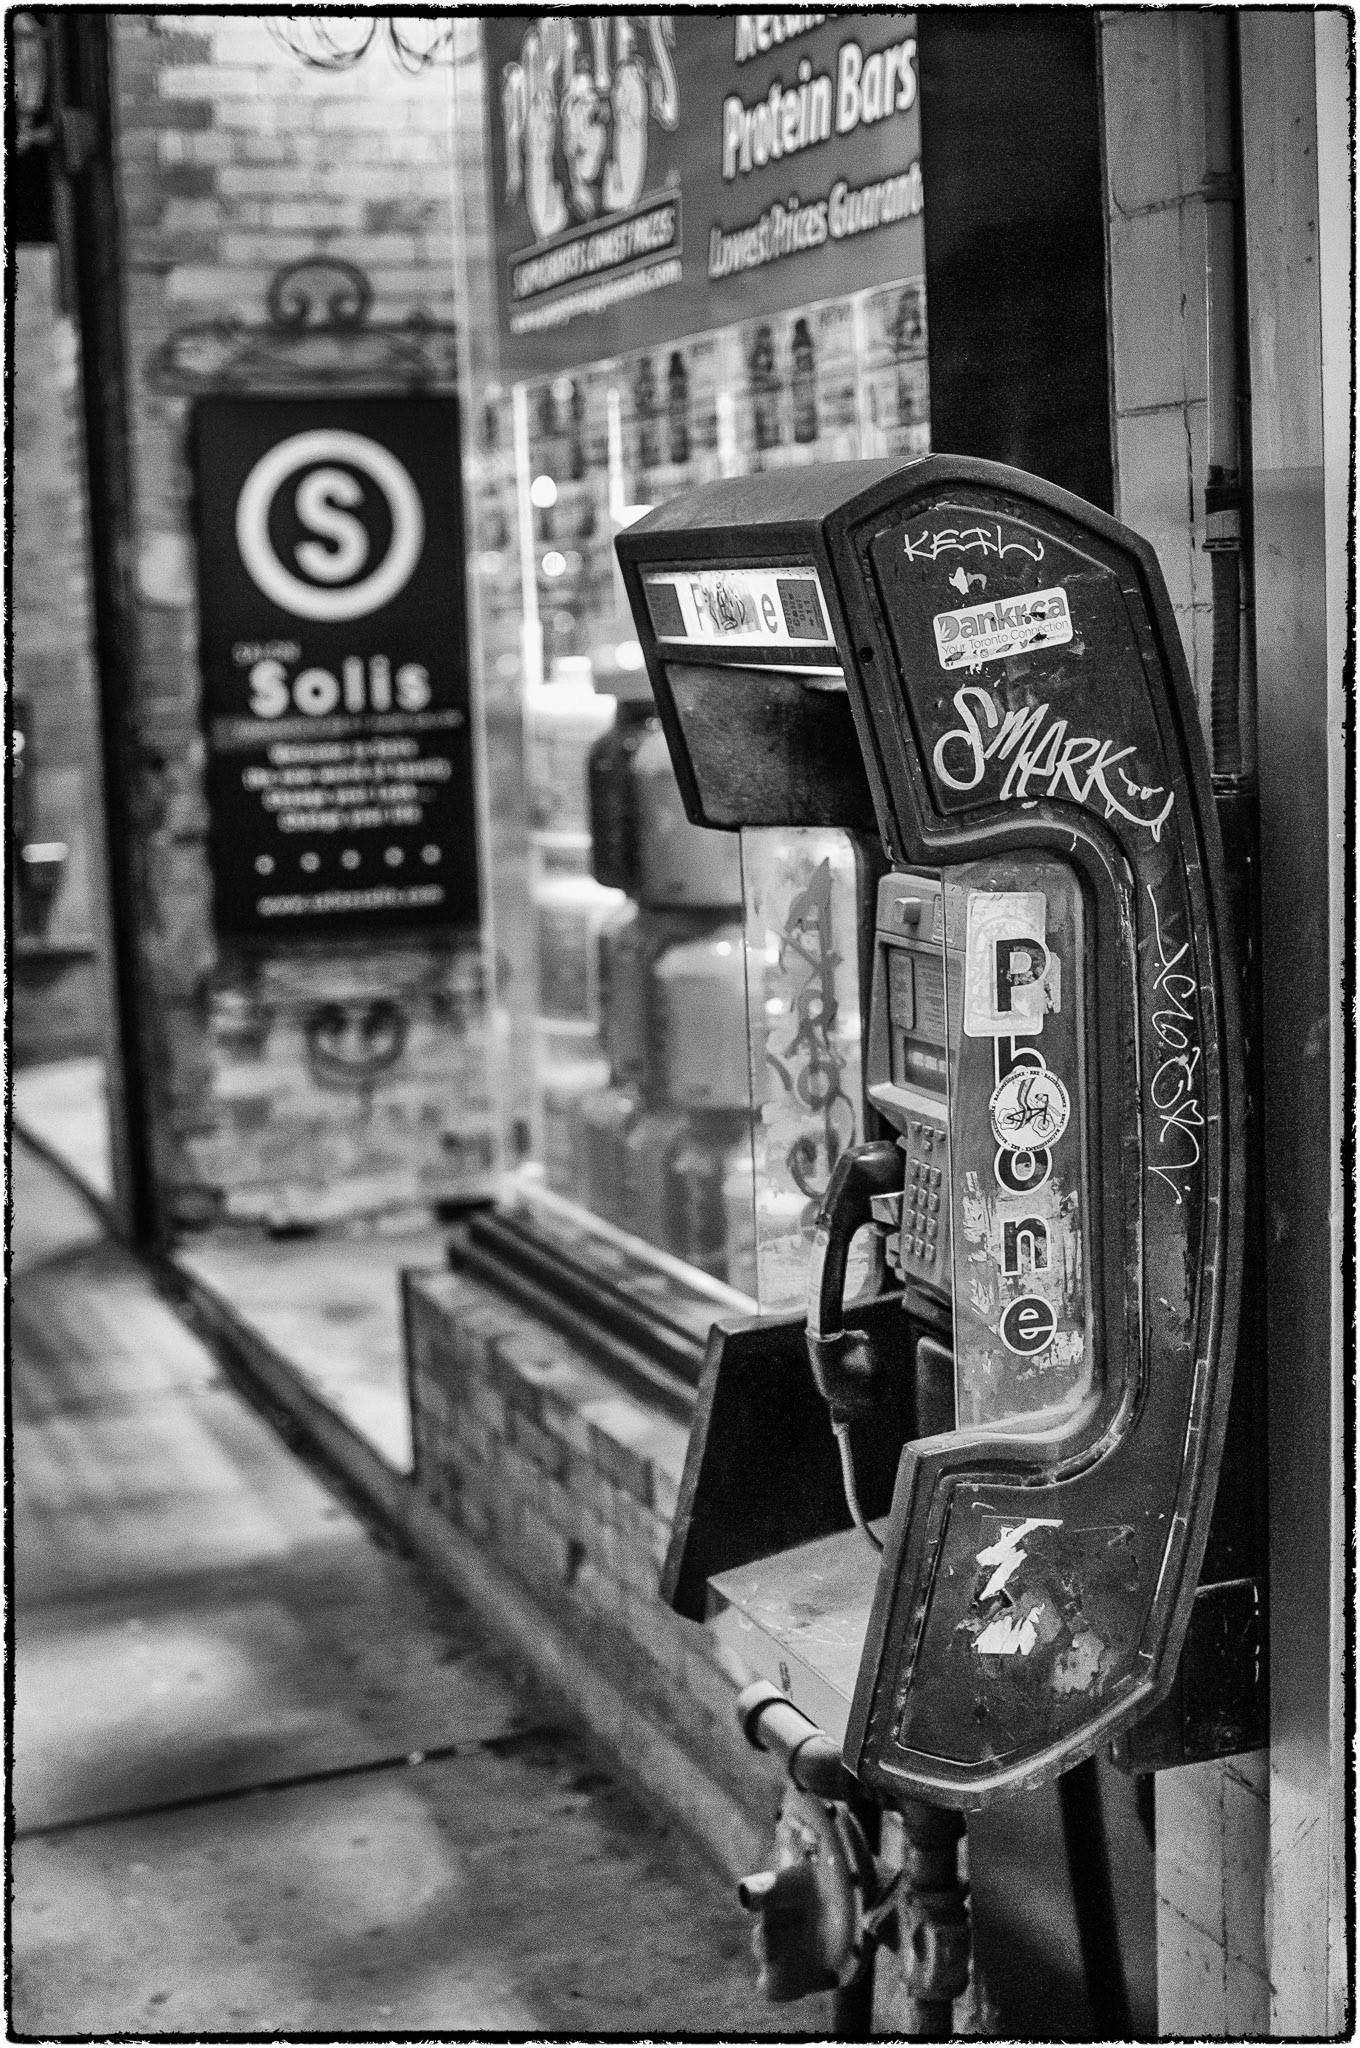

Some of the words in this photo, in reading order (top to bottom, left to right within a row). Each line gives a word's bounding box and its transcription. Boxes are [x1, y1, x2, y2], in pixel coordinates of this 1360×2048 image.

[722, 59, 832, 179] Protein
[835, 39, 917, 133] Bars
[708, 214, 770, 278] Lowest
[770, 197, 828, 258] Prices
[293, 467, 369, 583] S
[937, 597, 1067, 643] Dankr.ca
[942, 641, 966, 656] Your
[970, 634, 1009, 650] Toronto
[1010, 620, 1069, 641] Connection
[249, 654, 432, 718] Solis
